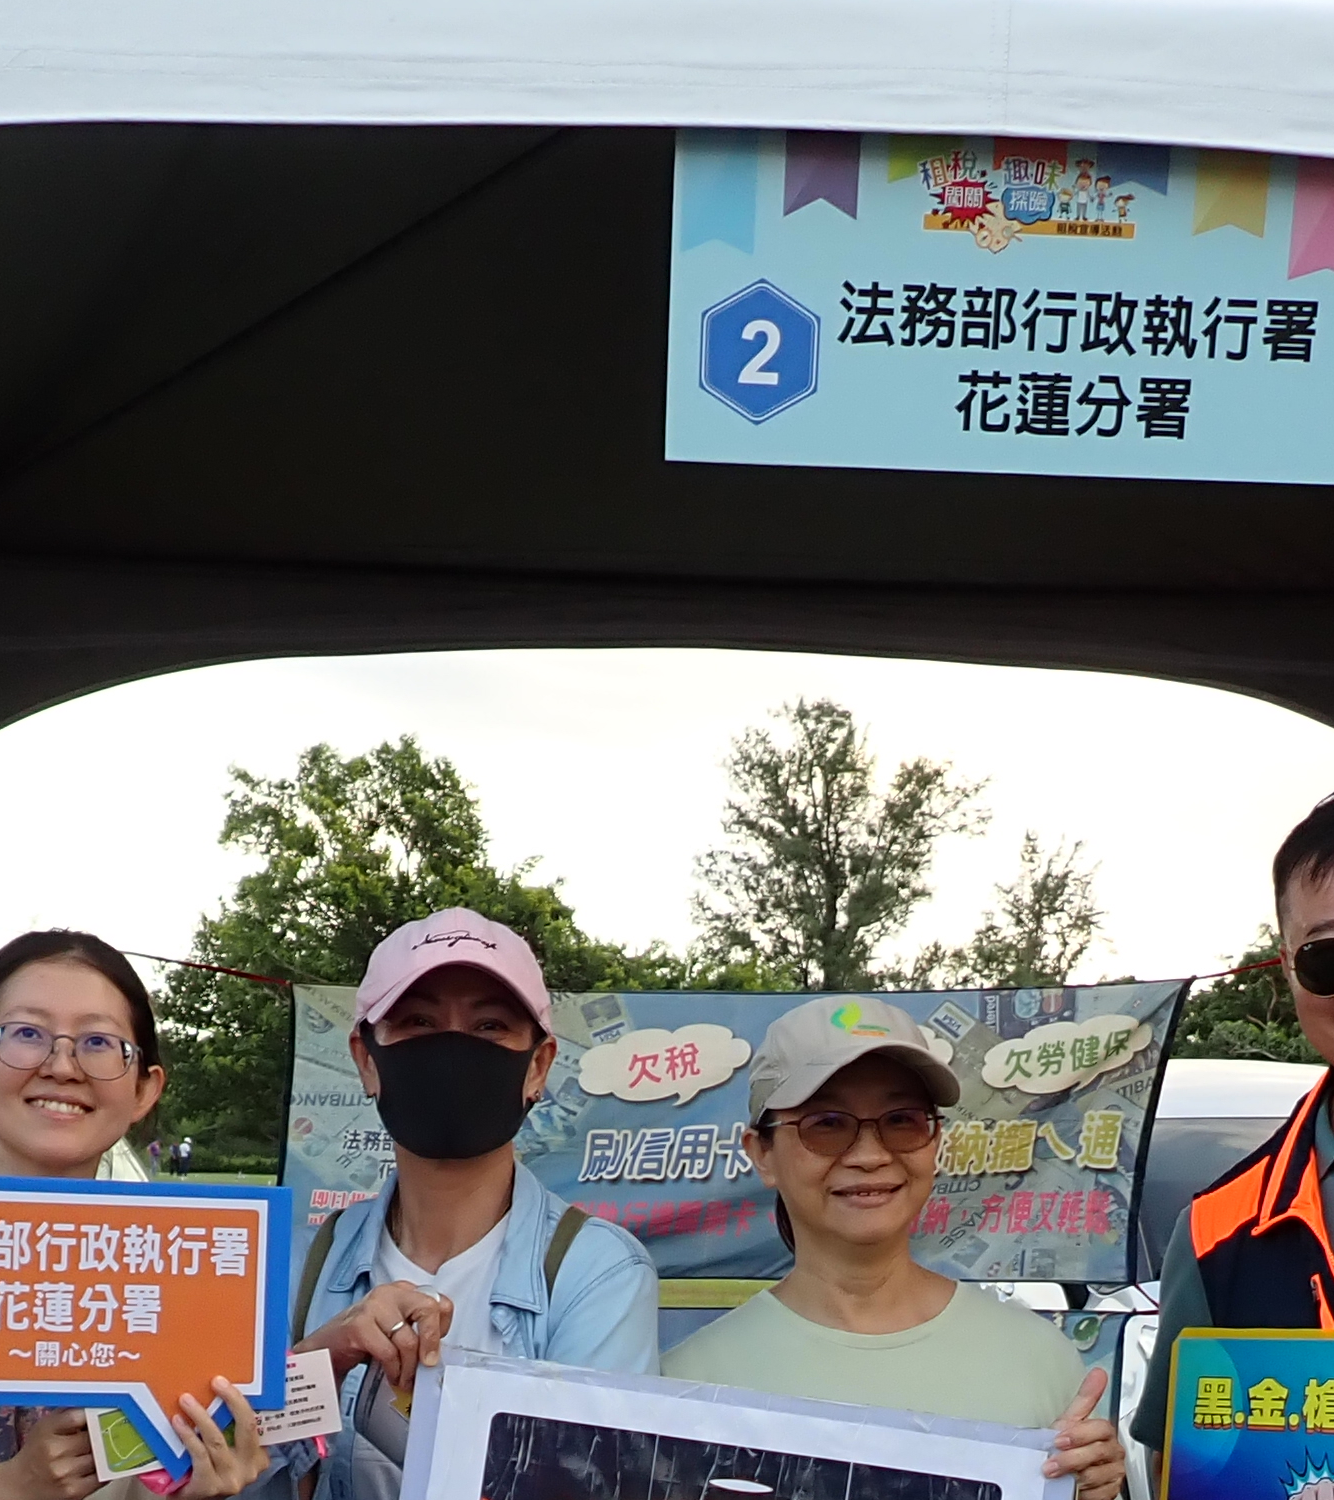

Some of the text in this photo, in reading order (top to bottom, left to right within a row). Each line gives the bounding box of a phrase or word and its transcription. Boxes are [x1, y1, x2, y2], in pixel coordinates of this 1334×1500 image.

[737, 319, 783, 386] 2
[836, 279, 1320, 363] 法務部行政執行署
[954, 369, 1192, 441] 花蓮分署
[627, 1042, 701, 1089] 欠稅
[1003, 1027, 1134, 1084] 欠勞健保
